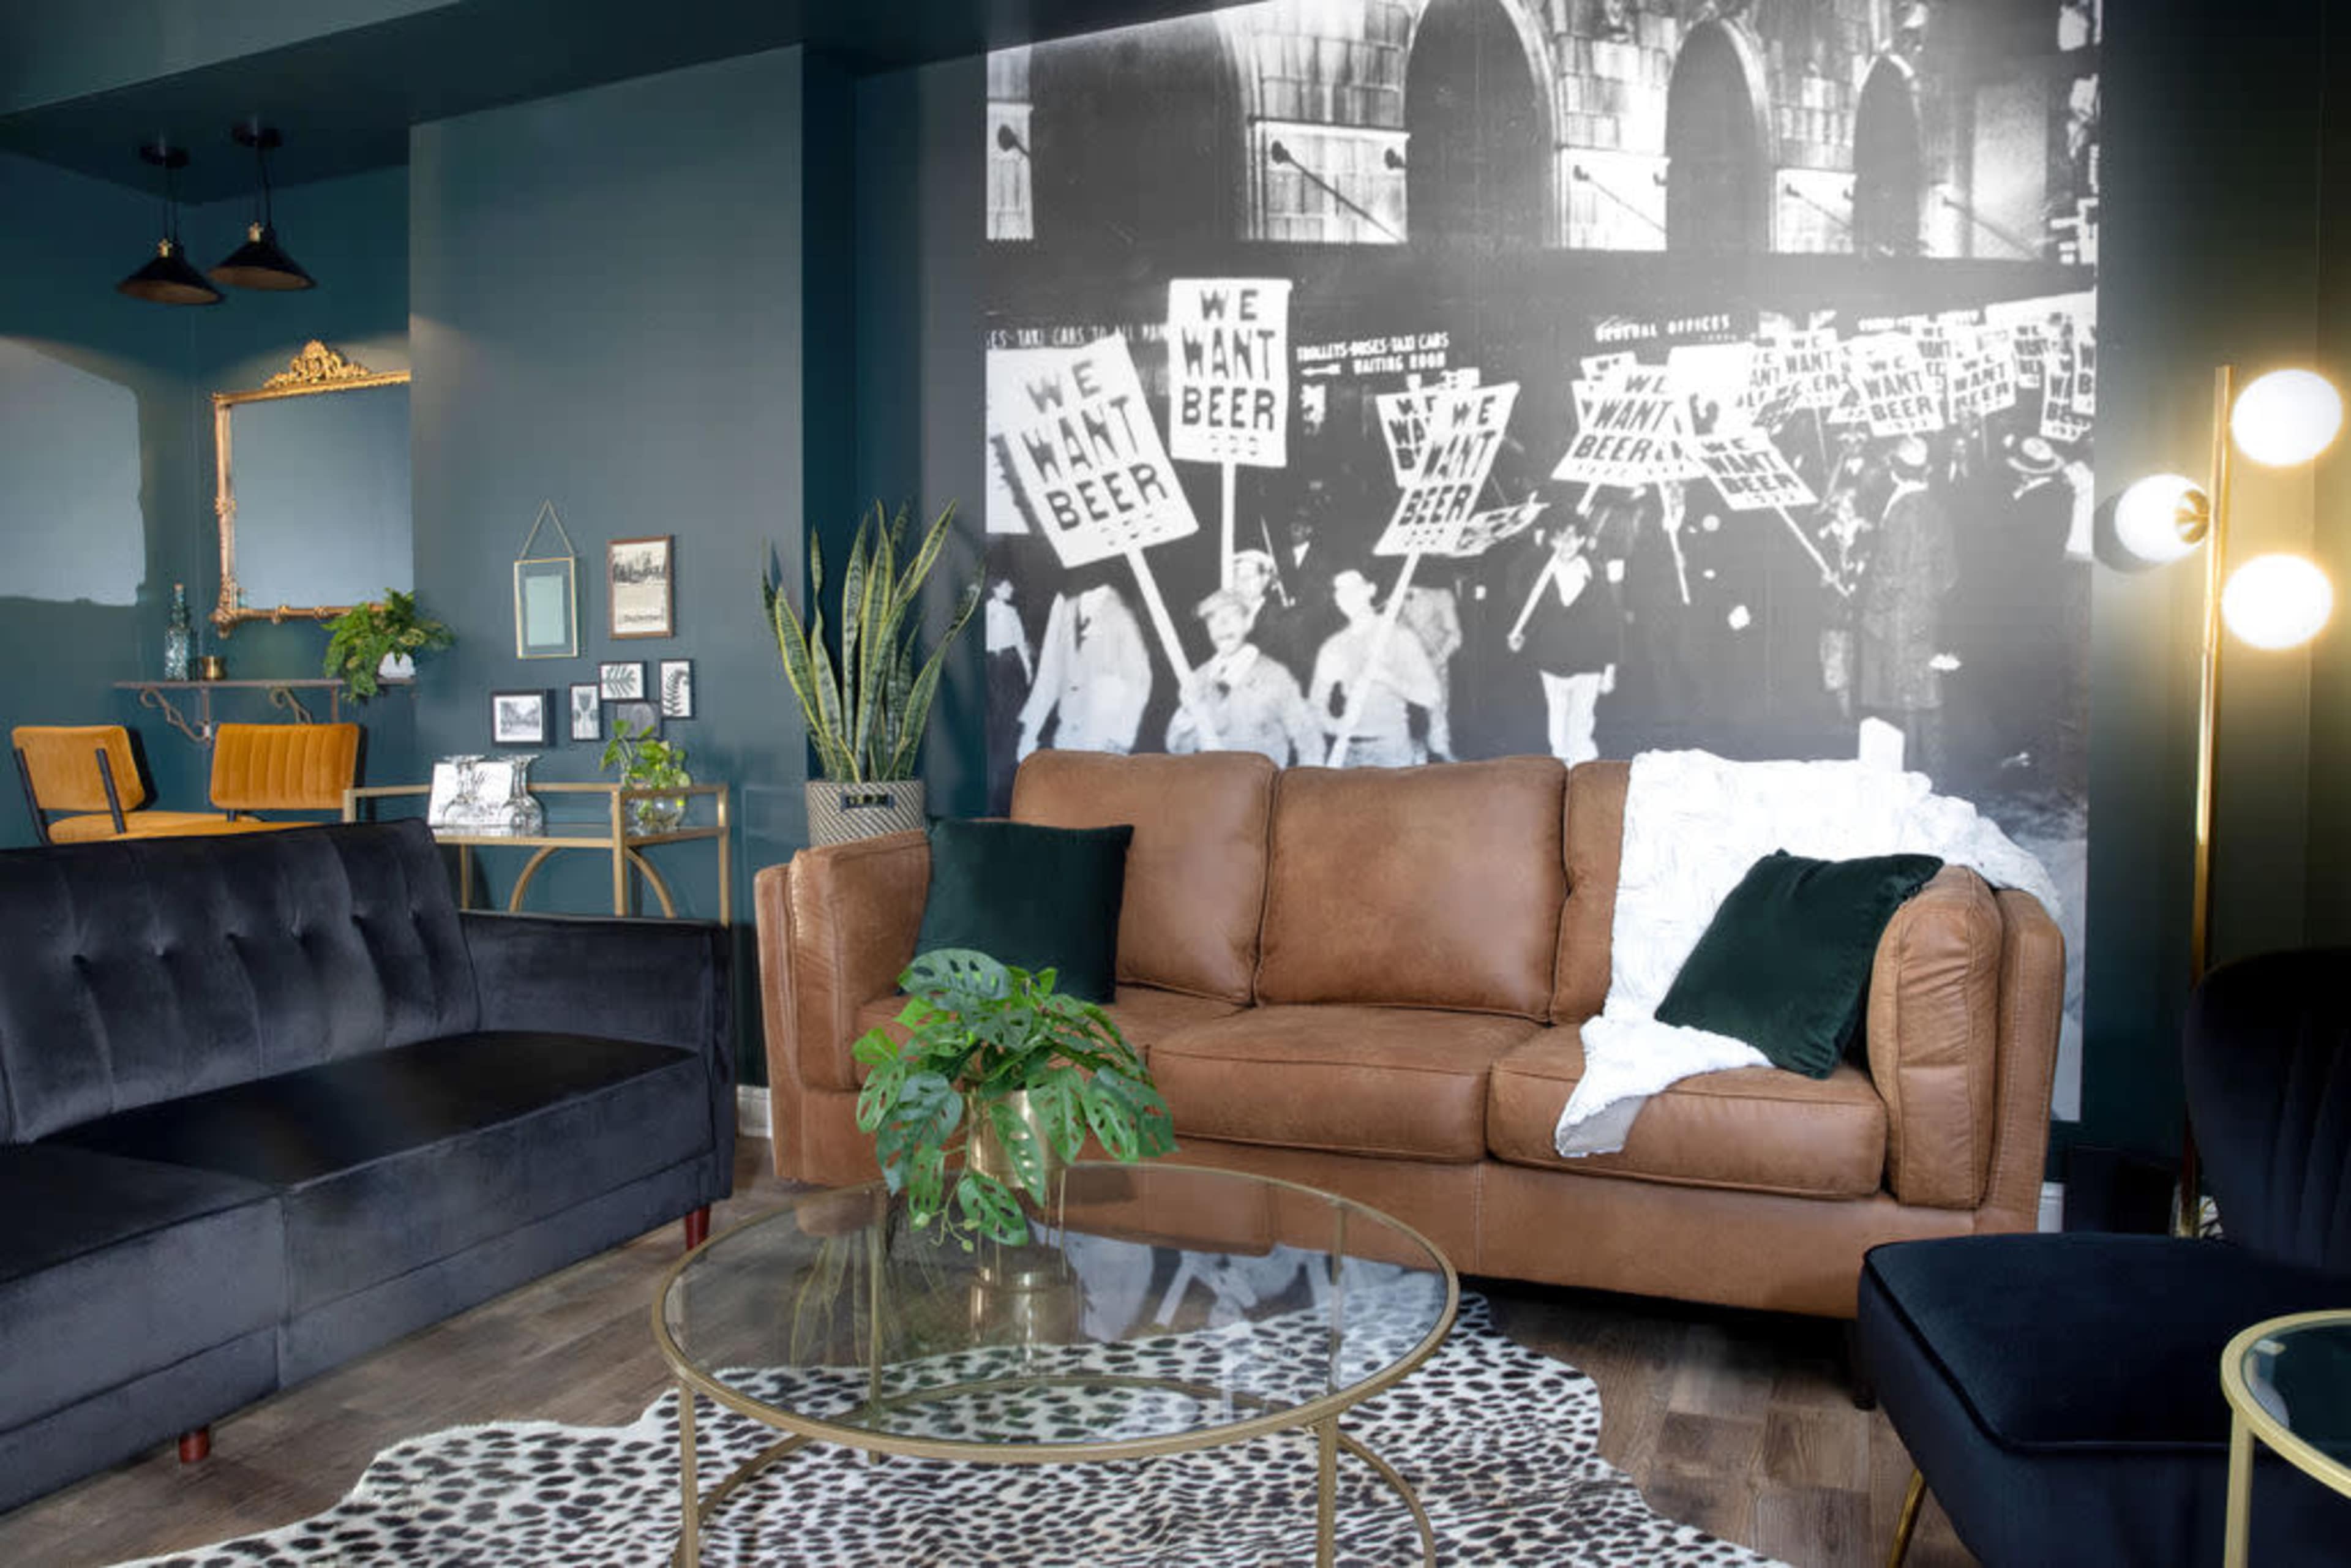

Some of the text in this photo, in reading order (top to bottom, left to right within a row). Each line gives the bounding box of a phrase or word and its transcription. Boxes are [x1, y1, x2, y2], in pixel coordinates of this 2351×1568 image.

[1201, 288, 1258, 321] WE
[1182, 328, 1276, 381] WANT
[1026, 359, 1101, 415] WE
[1862, 370, 1923, 400] WANT
[1182, 386, 1276, 431] BEER
[1452, 394, 1497, 427] WE
[1593, 399, 1674, 432] WANT
[1870, 395, 1934, 421] BEER
[1021, 395, 1139, 484] WANT
[1573, 434, 1654, 463] BEER
[1045, 463, 1168, 531] BEER
[1398, 484, 1473, 527] BEER
